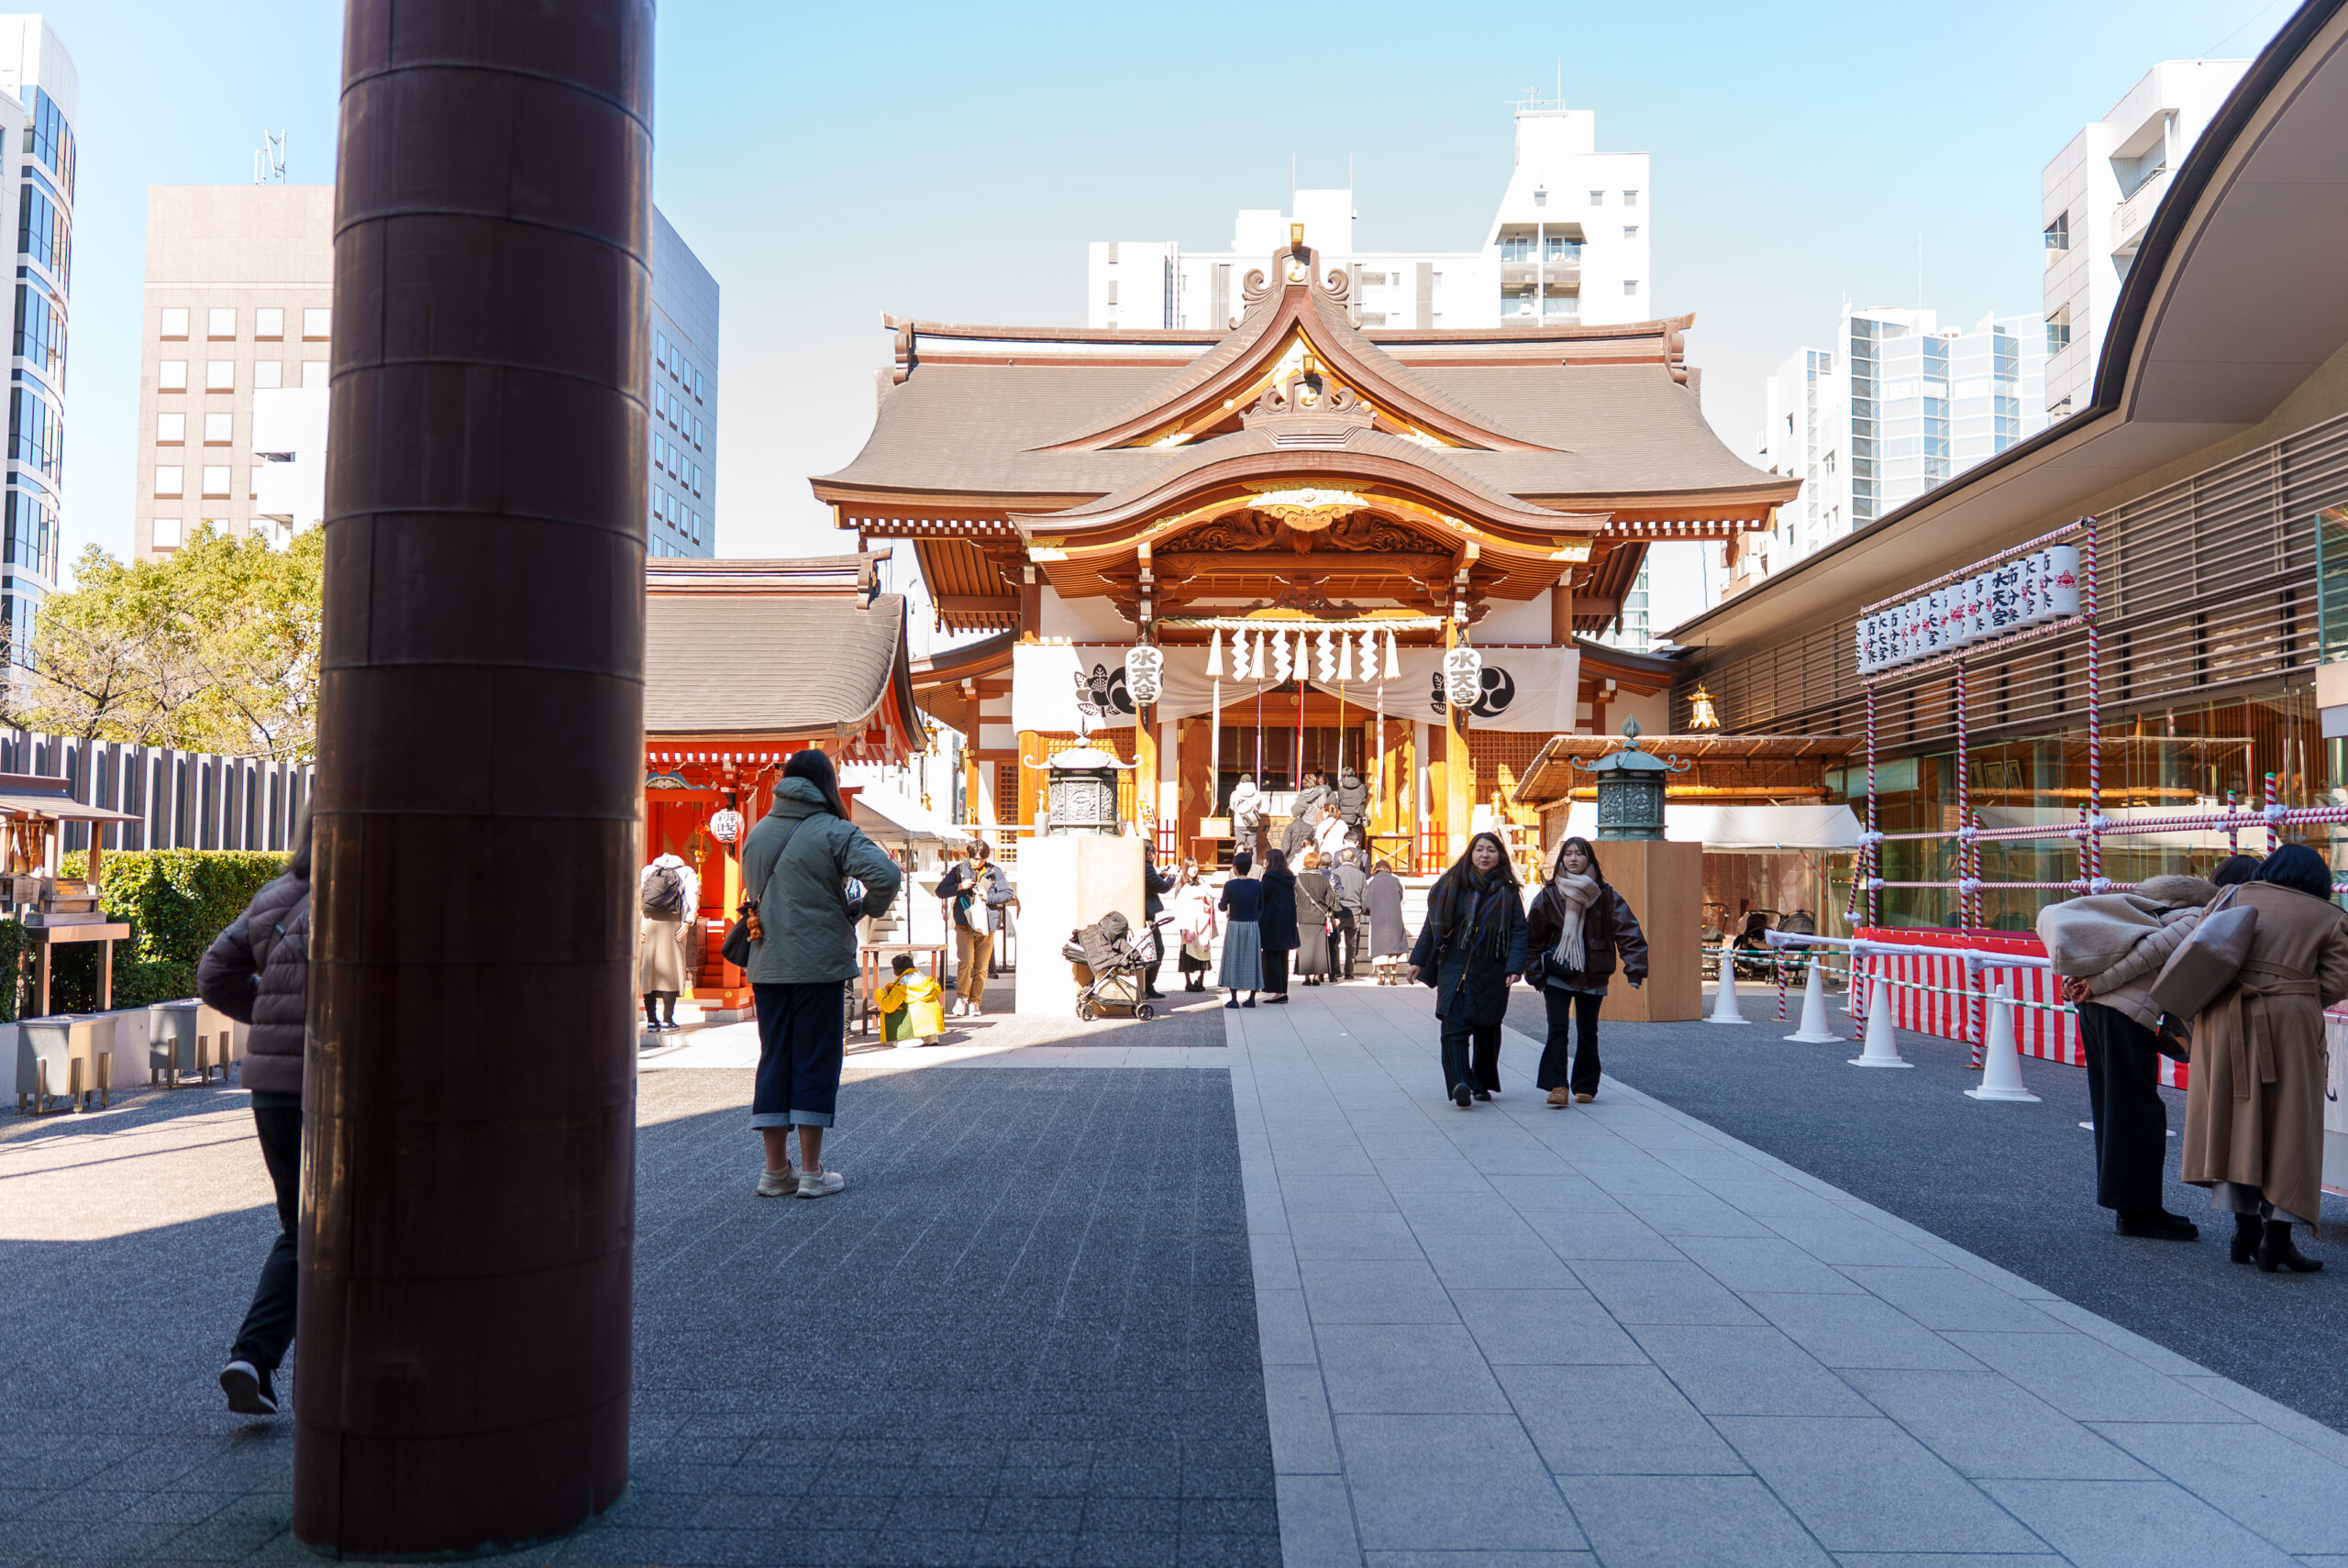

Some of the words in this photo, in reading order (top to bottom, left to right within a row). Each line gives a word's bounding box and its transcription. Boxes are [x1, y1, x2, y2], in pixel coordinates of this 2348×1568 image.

[1992, 572, 2009, 626] 水天宮
[1131, 649, 1157, 701] 水天宮
[1450, 652, 1475, 704] 水天宮
